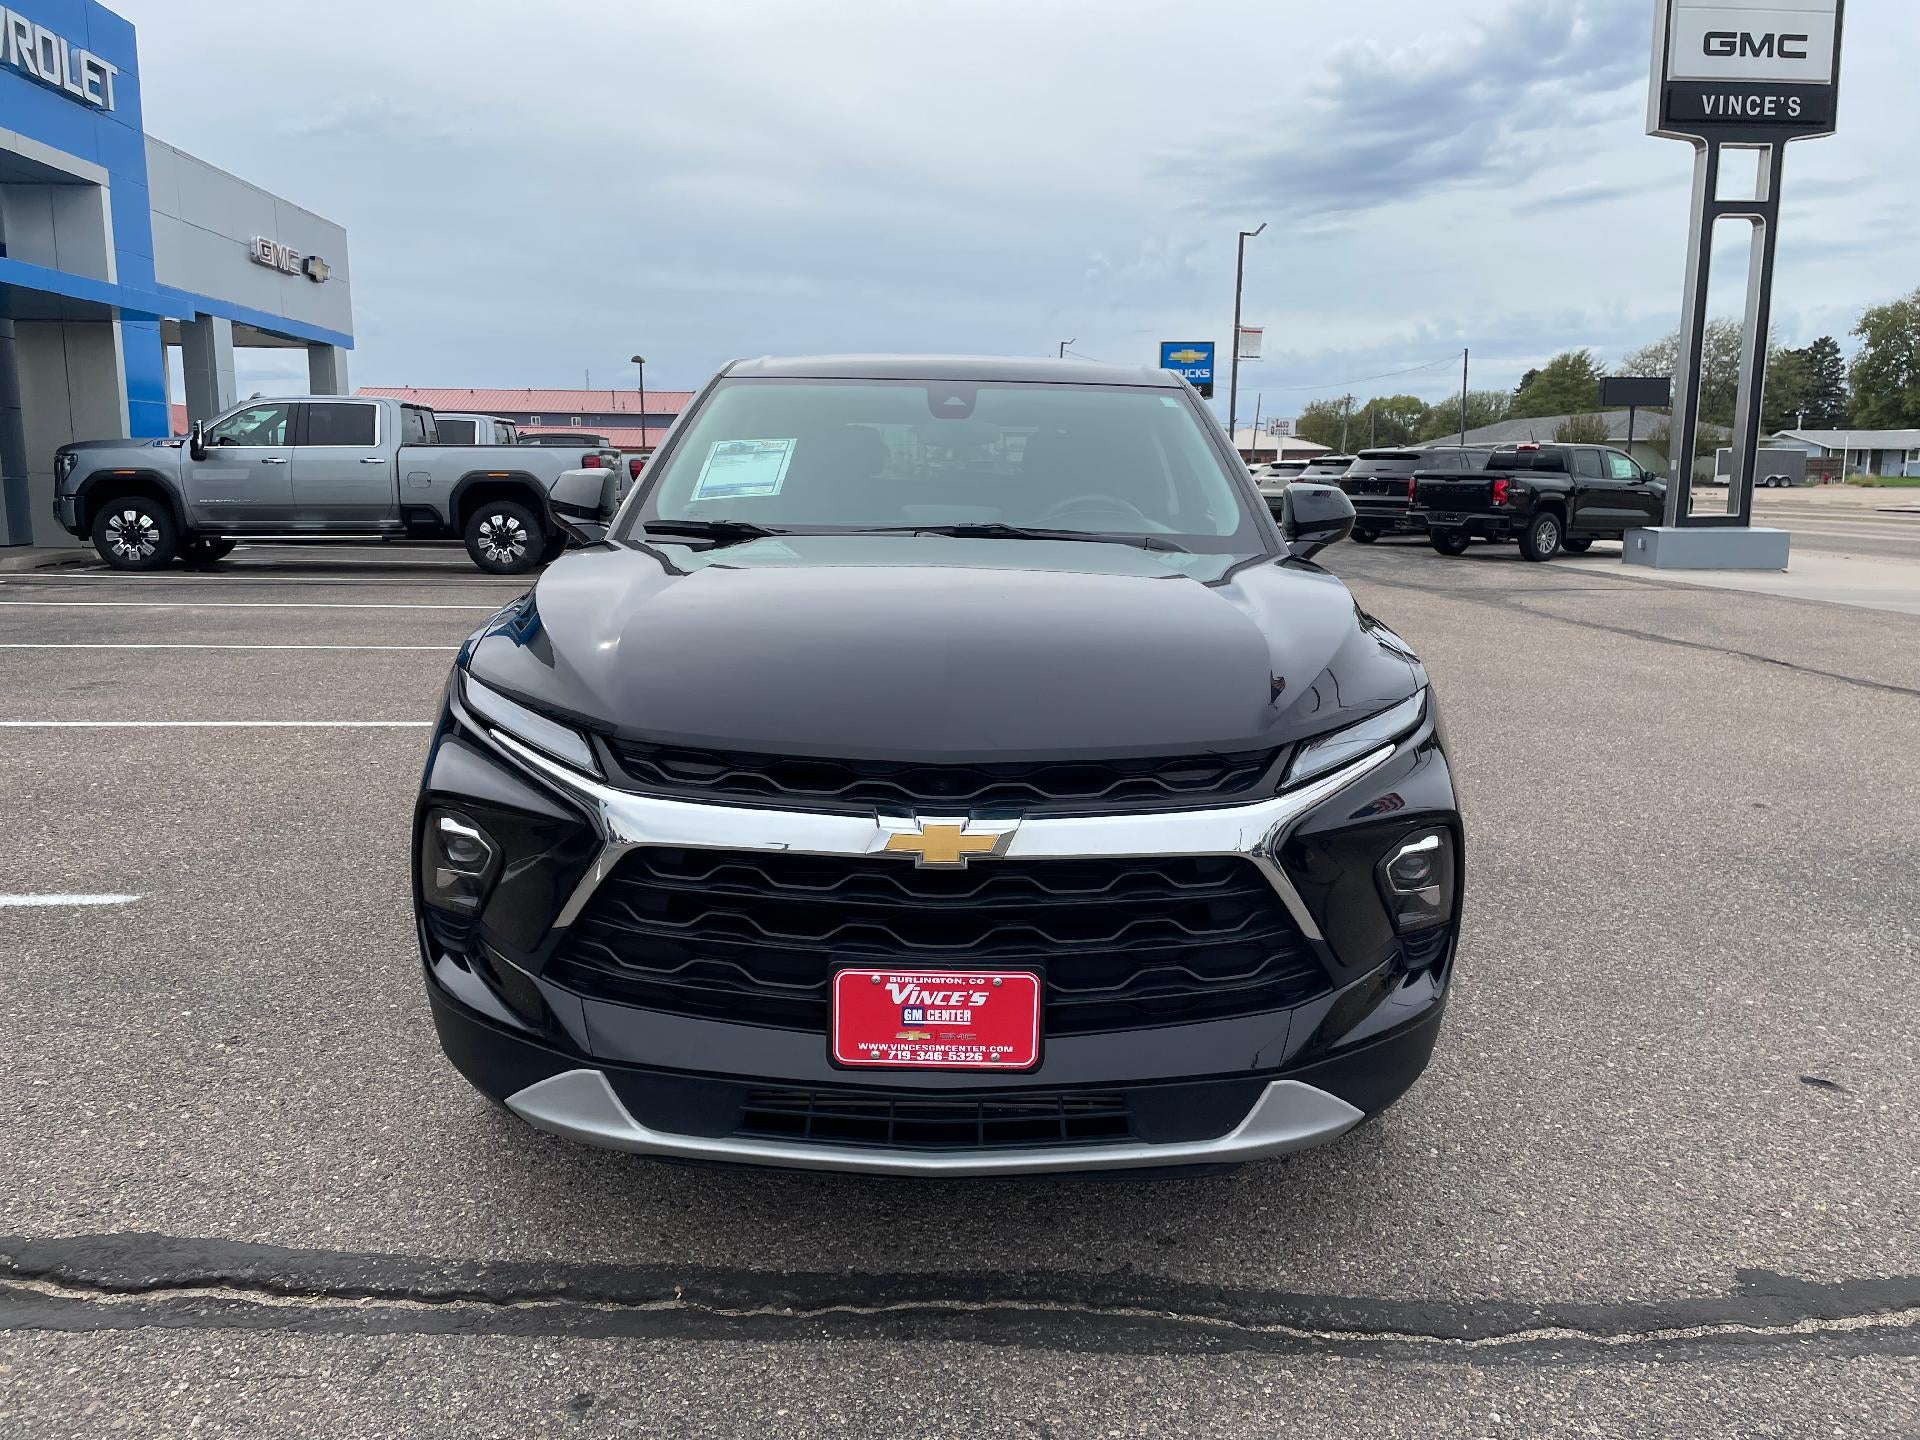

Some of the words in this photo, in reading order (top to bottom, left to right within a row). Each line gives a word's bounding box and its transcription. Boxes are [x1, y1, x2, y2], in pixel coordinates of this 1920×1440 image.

[1702, 31, 1809, 59] GMC
[1701, 94, 1802, 117] VINCE'S
[256, 235, 301, 275] GMC
[1177, 368, 1210, 378] UCKS
[889, 976, 966, 985] BURLINGTON,
[903, 1009, 923, 1021] GM
[926, 1009, 972, 1022] CENTER
[858, 1042, 1014, 1053] WWW.VINCESGMCENTER.COM
[888, 1050, 983, 1061] 719-346-5326
